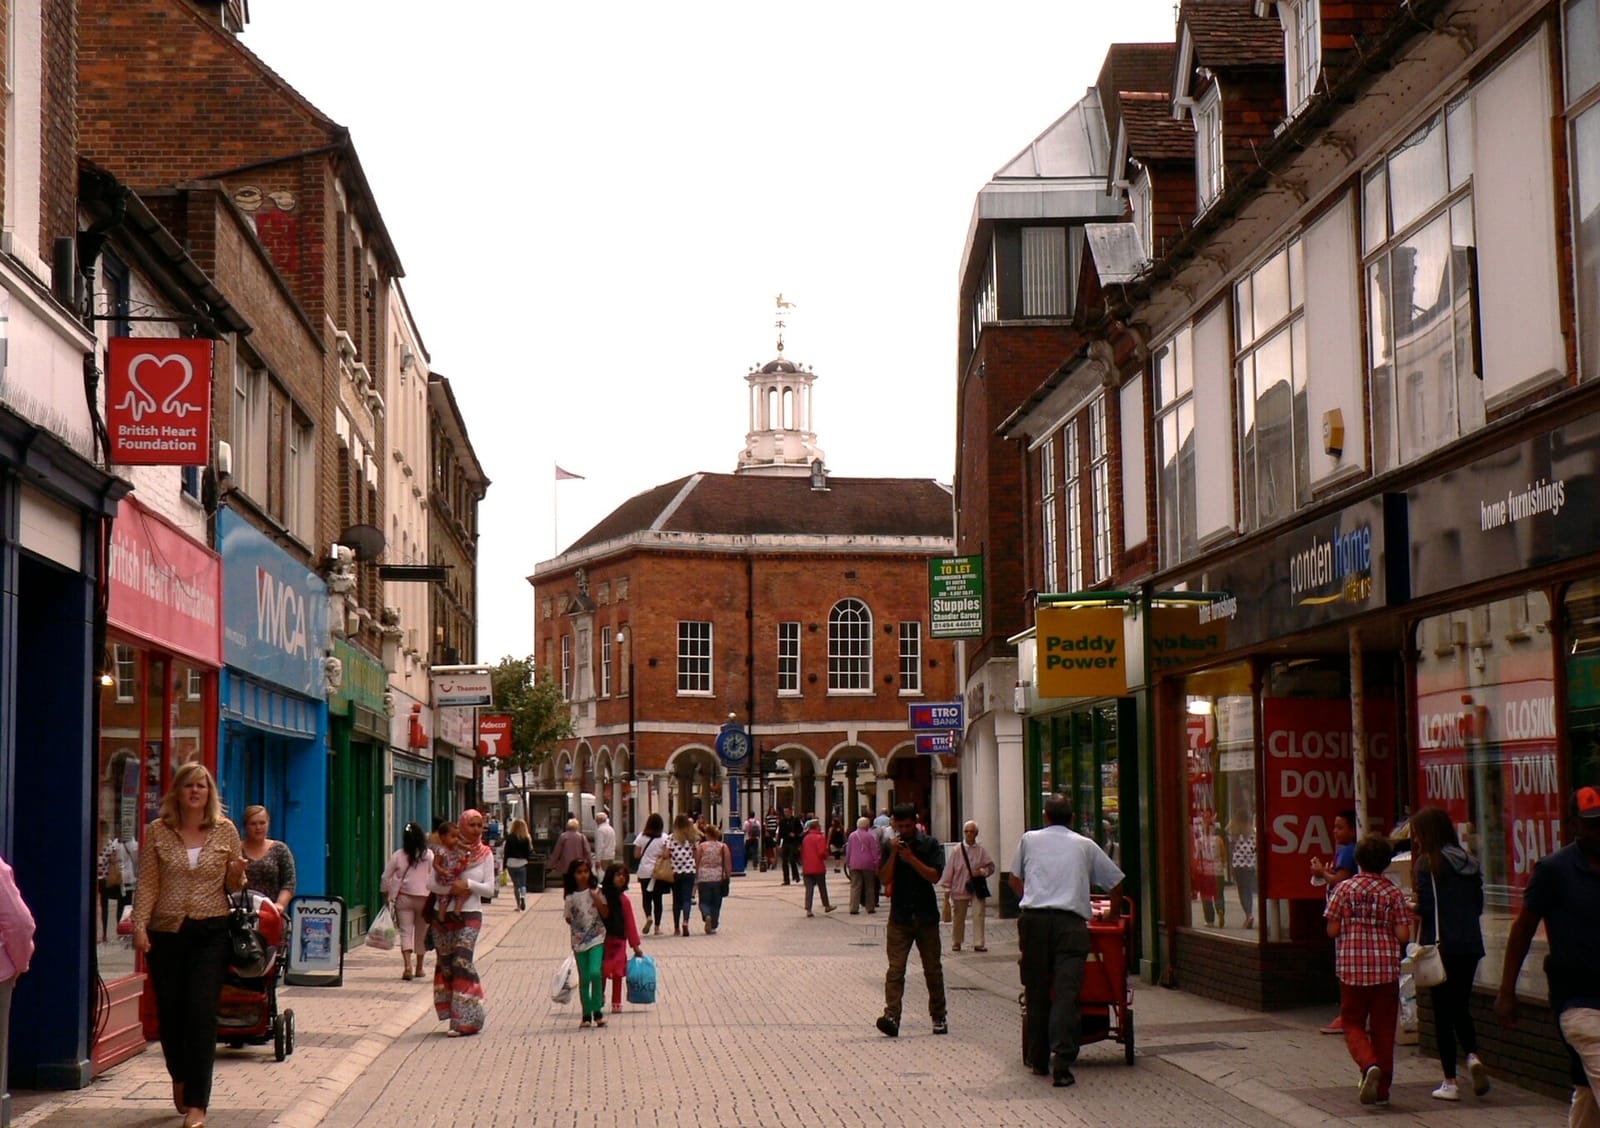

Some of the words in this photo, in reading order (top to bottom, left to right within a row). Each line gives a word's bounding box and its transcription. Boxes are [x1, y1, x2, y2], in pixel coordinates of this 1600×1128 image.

[118, 425, 158, 436] British
[161, 426, 197, 437] Heart
[118, 438, 197, 450] Foundation
[1481, 500, 1506, 531] home
[1508, 478, 1565, 516] furnishings
[941, 565, 952, 575] TO
[955, 564, 971, 574] LET
[1290, 535, 1332, 607] ponden
[1333, 526, 1370, 579] home
[142, 548, 169, 605] Heart
[933, 598, 980, 612] Stupples
[256, 565, 308, 661] YMCA
[1046, 635, 1116, 653] Paddy
[1046, 655, 1118, 669] Power
[480, 721, 507, 729] Adecco
[932, 718, 959, 726] BANK
[1512, 753, 1559, 794] DOWN
[1426, 764, 1465, 800] DOWN
[296, 907, 338, 916] YMCA
